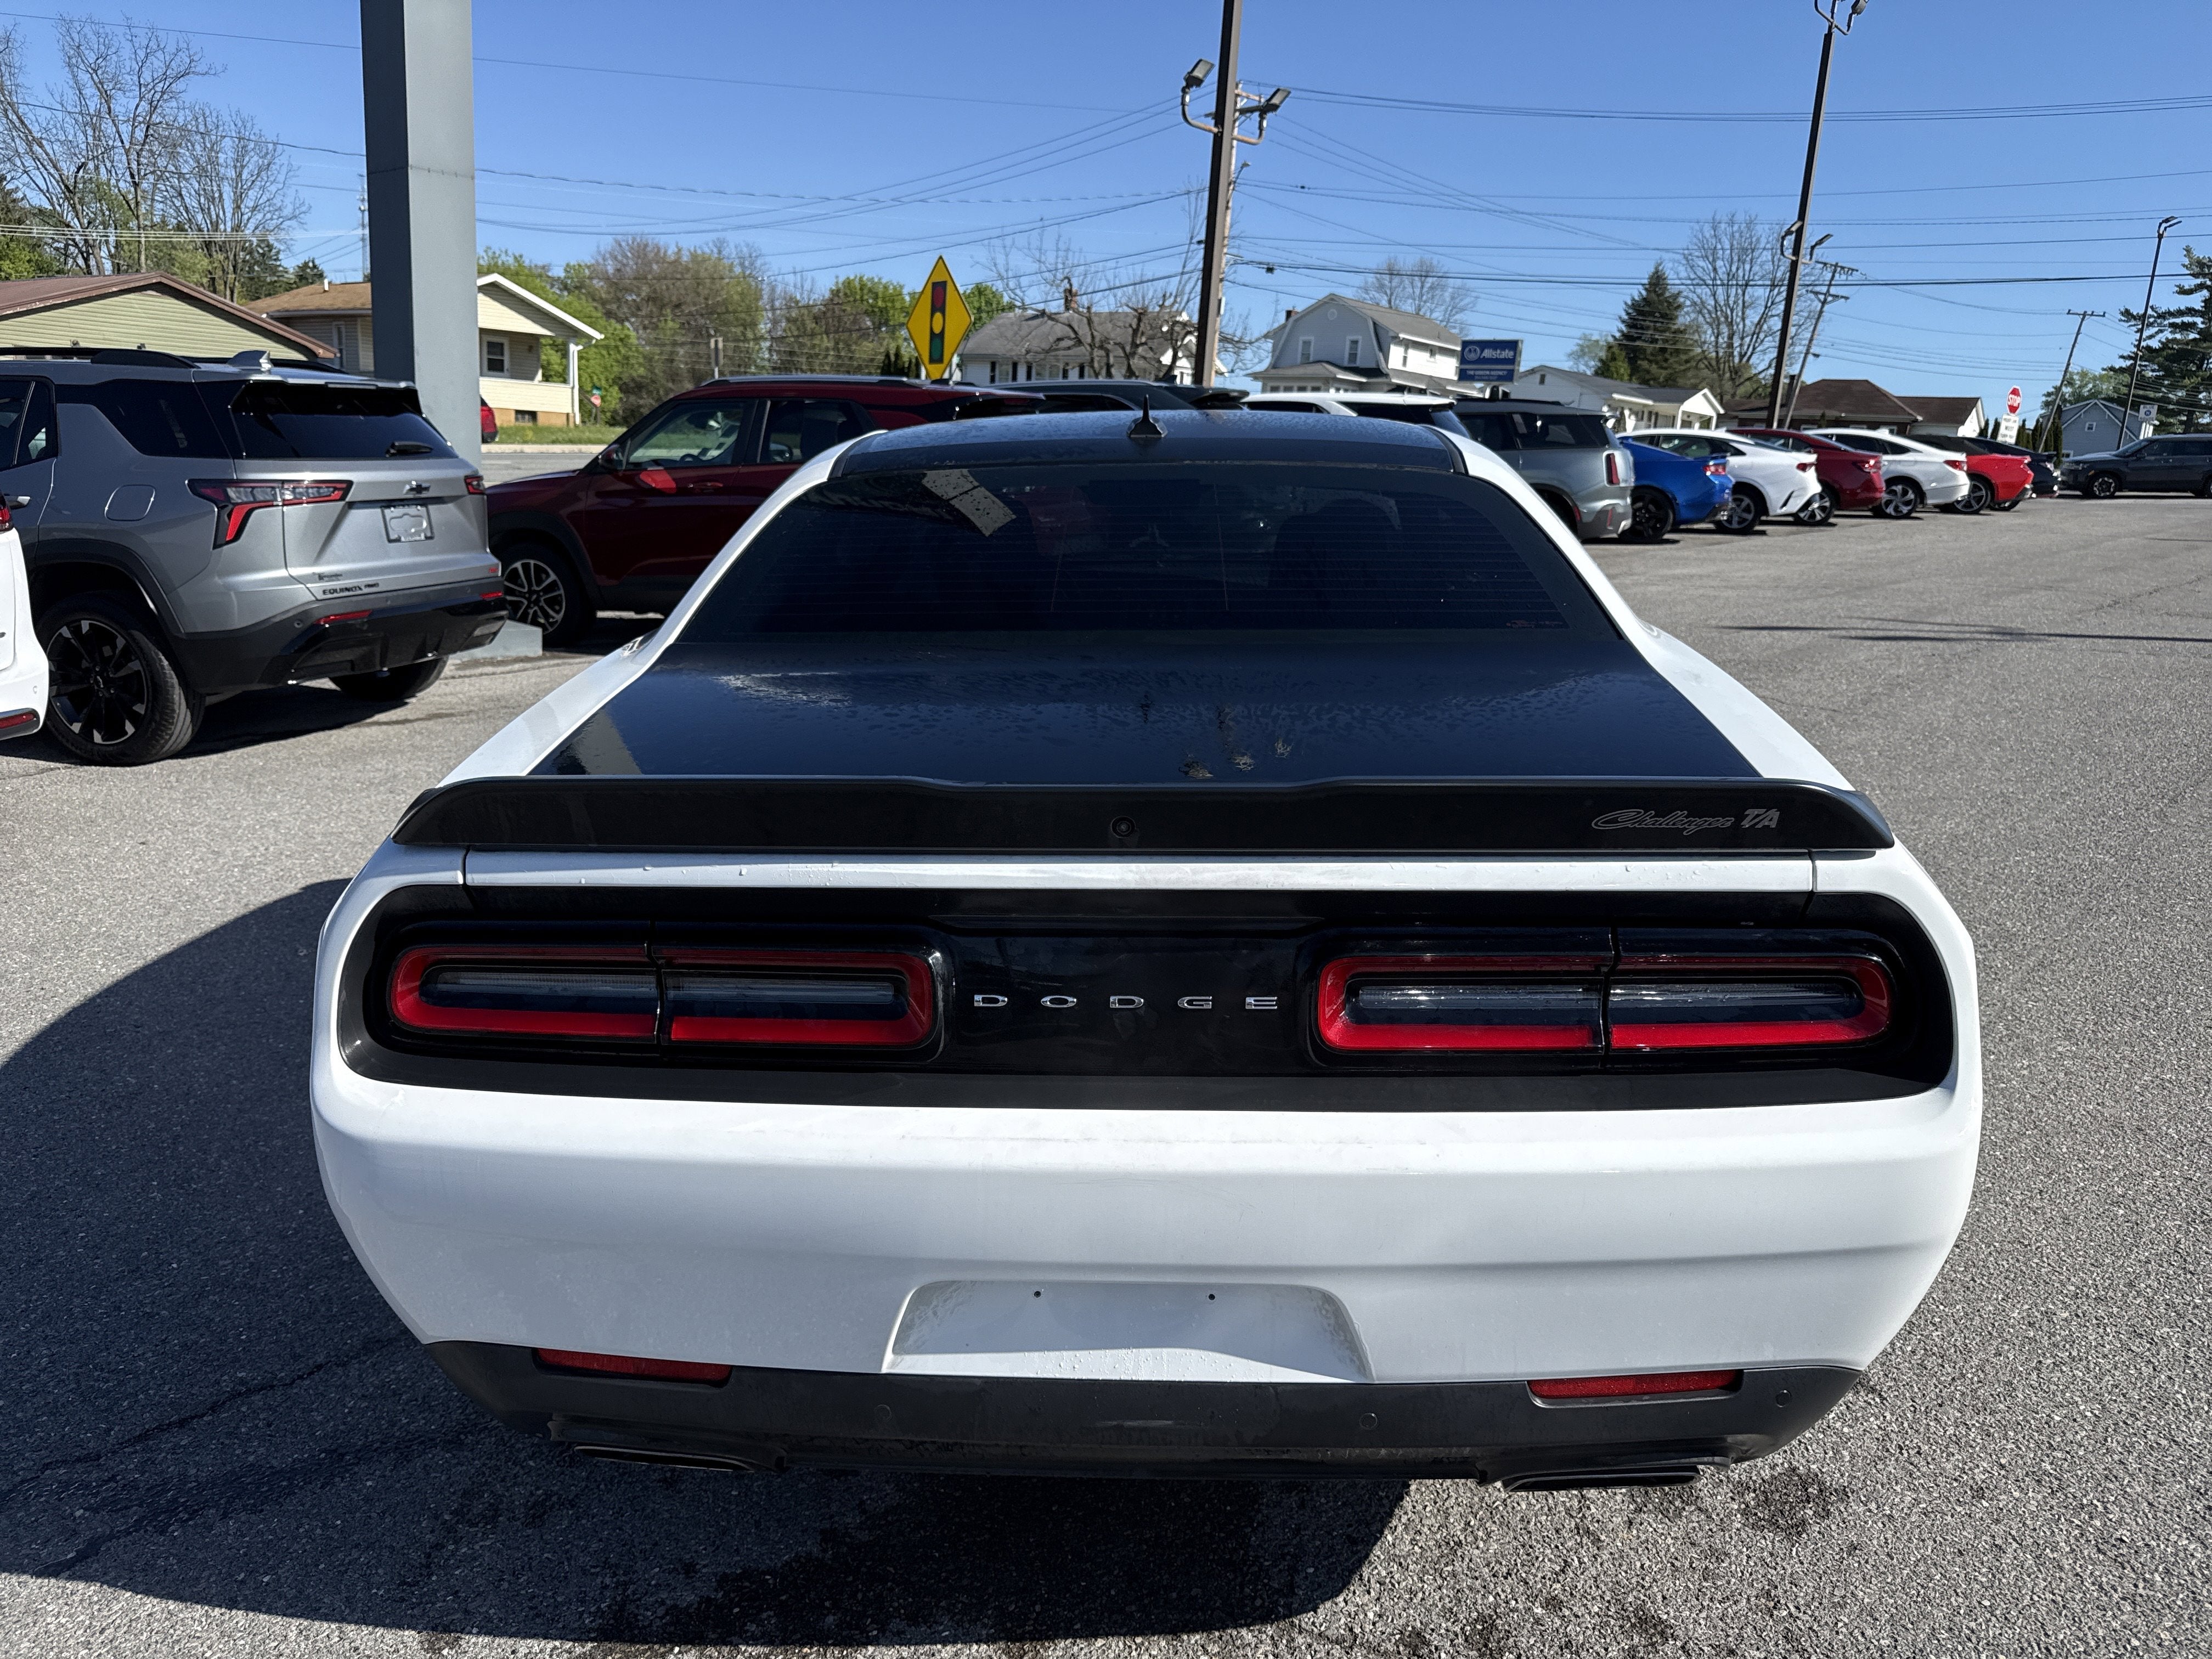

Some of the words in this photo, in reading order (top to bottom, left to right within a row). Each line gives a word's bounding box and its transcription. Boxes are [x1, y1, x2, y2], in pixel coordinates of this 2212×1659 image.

[1480, 348, 1515, 359] Allstate
[2008, 394, 2021, 406] STOP
[323, 585, 363, 595] EQUINOX
[1592, 809, 1735, 836] Challenger
[974, 994, 1278, 1009] DODGE
